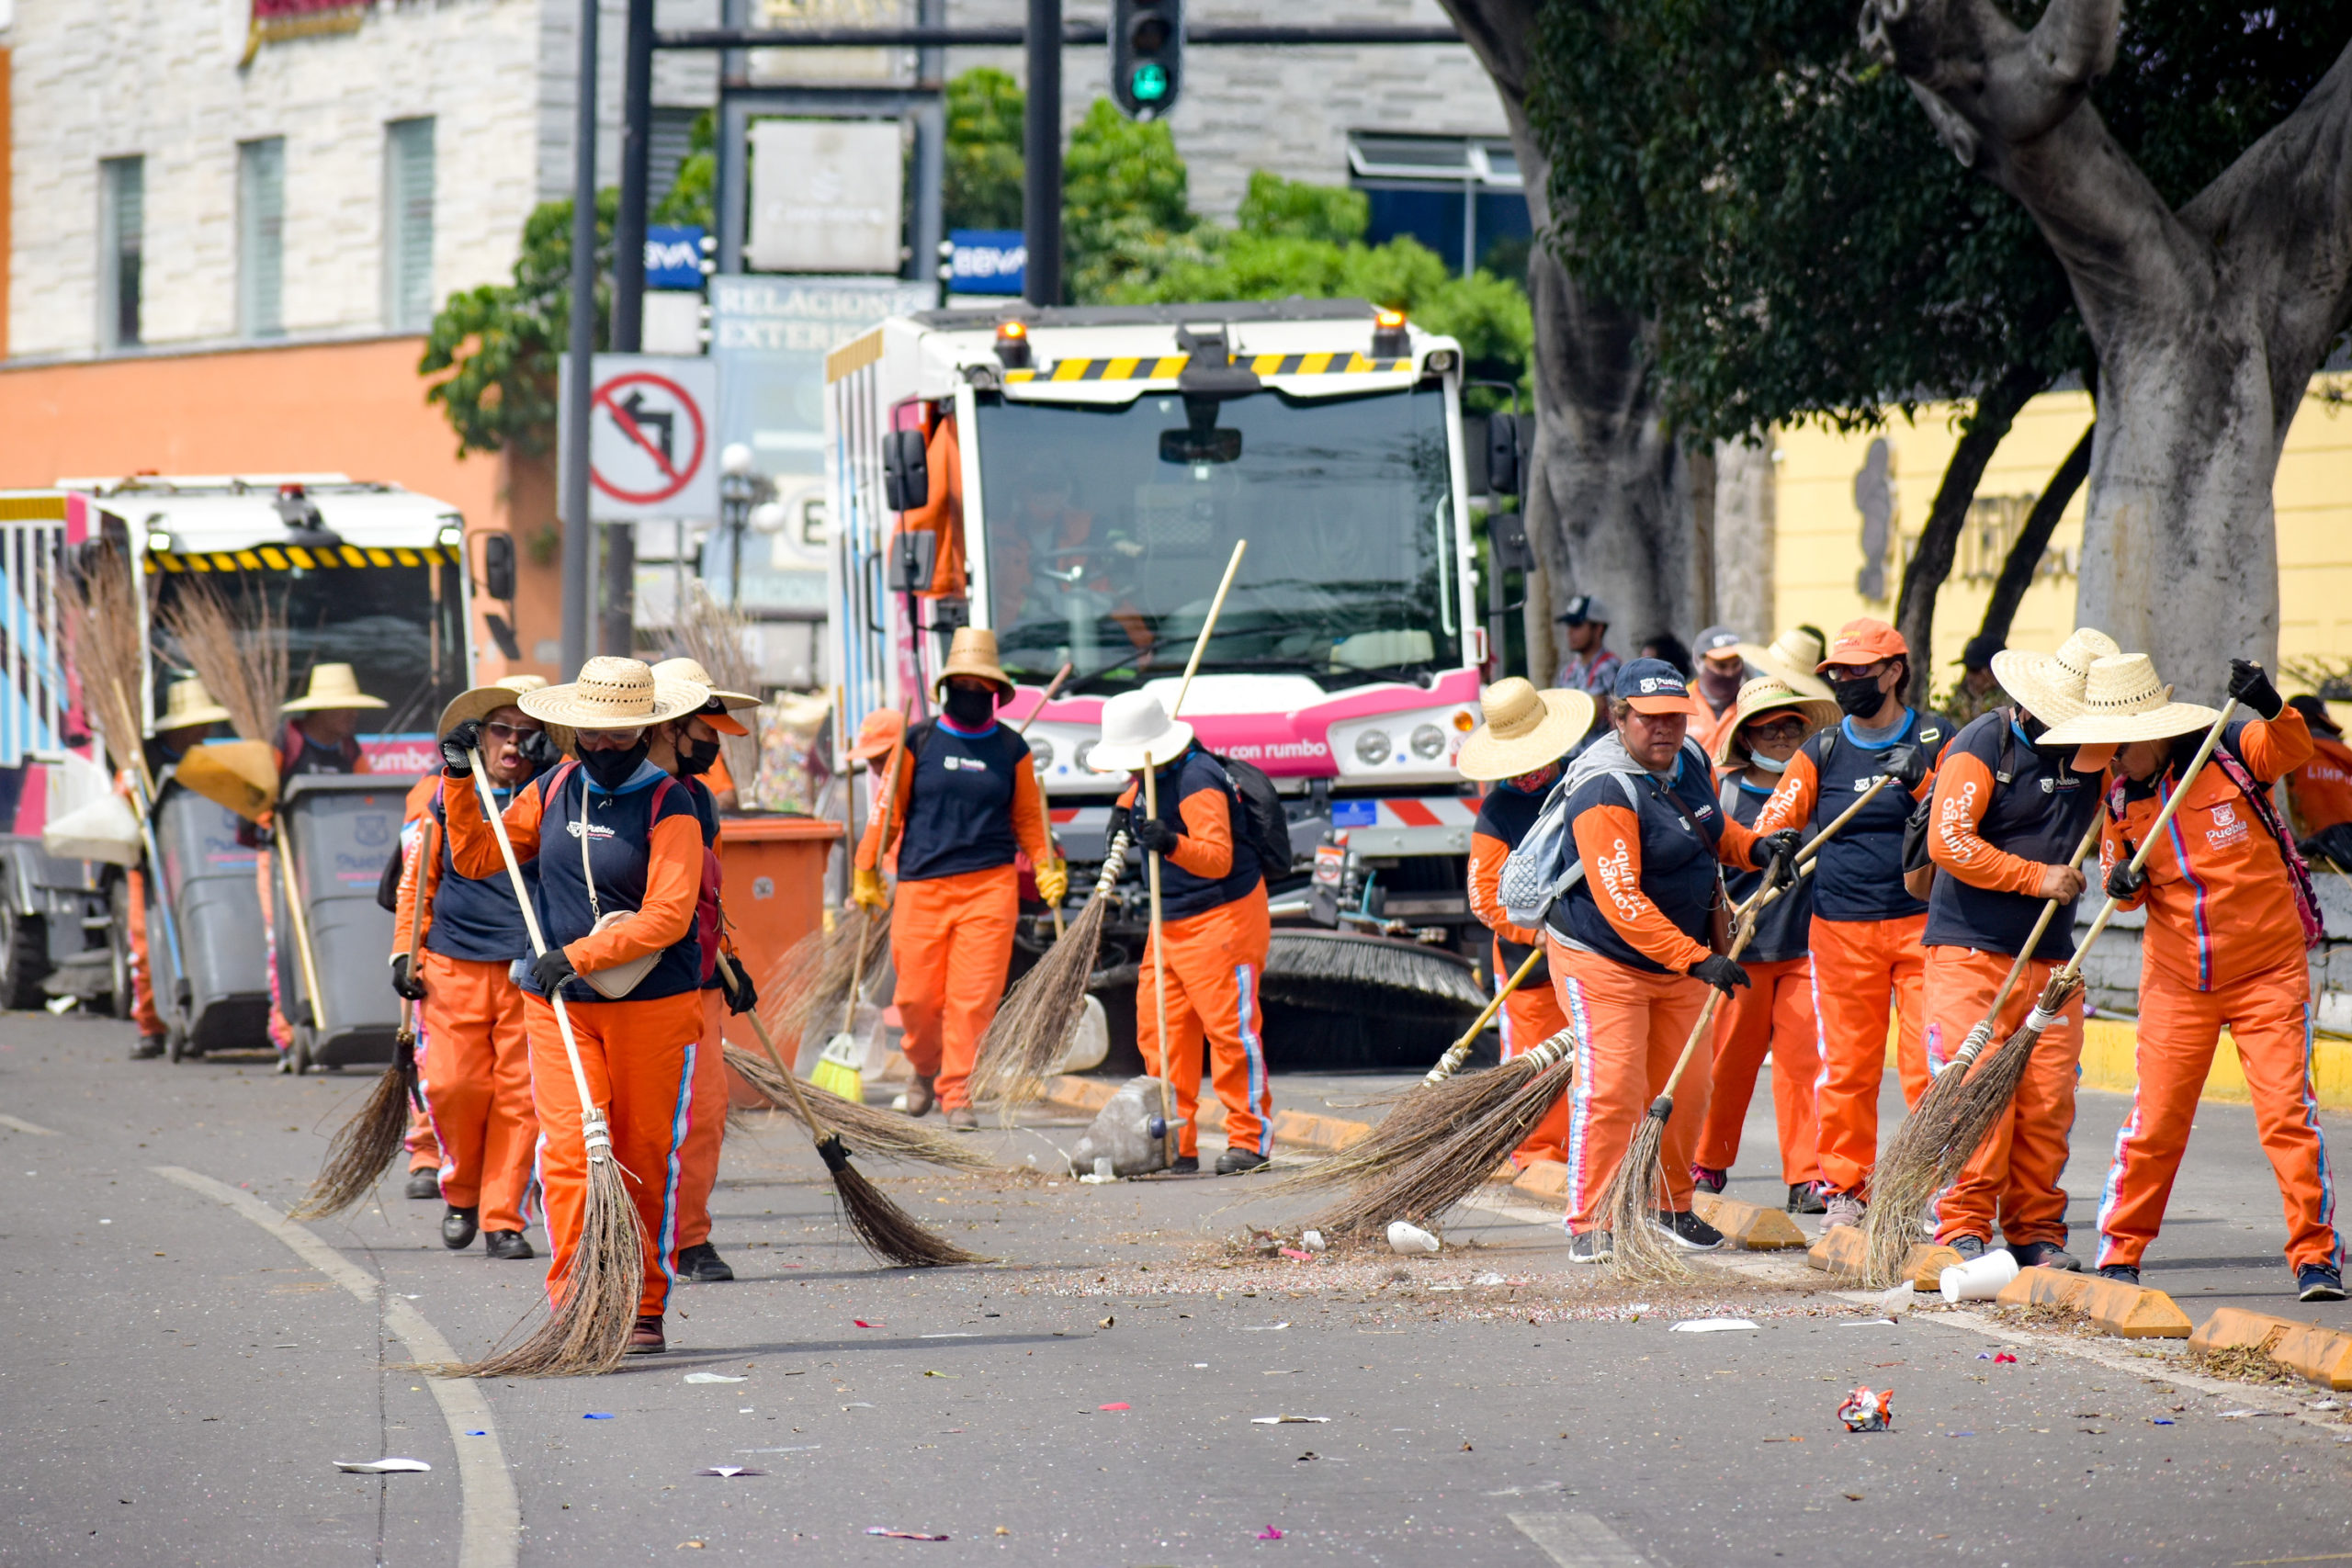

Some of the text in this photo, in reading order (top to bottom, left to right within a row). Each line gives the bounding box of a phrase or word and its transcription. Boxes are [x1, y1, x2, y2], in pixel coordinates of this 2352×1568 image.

[644, 240, 699, 270] BVA
[718, 318, 856, 350] EXTERI
[368, 746, 438, 772] umbo
[1229, 745, 1261, 759] con
[1264, 738, 1327, 759] rumbo
[1694, 805, 1712, 818] uebla
[2206, 820, 2247, 842] Puebla
[1598, 856, 1637, 921] Contigo
